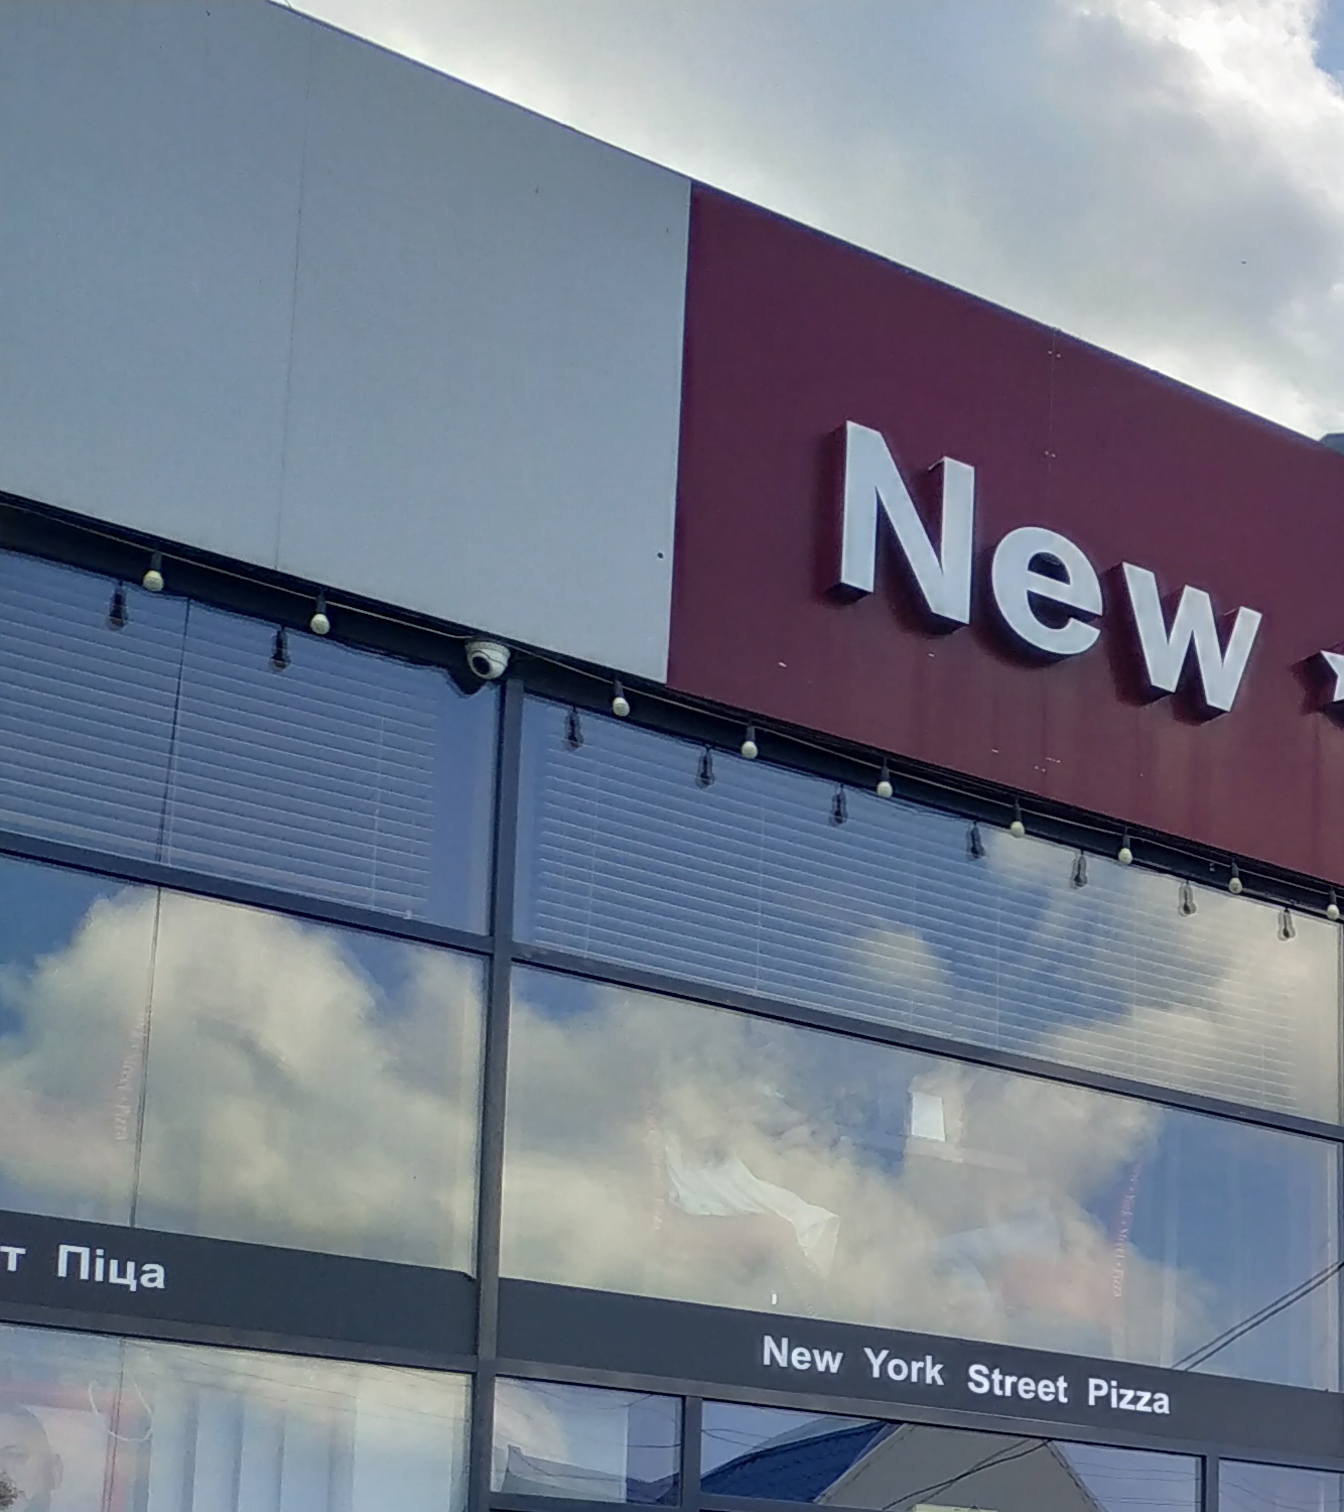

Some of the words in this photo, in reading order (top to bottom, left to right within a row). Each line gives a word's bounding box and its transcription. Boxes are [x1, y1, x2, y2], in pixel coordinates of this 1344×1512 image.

[836, 418, 1263, 714] New
[57, 1244, 166, 1292] Піца
[762, 1335, 843, 1374] New
[864, 1346, 944, 1387] York
[967, 1363, 1069, 1404] Street
[1088, 1377, 1171, 1415] Pizza
